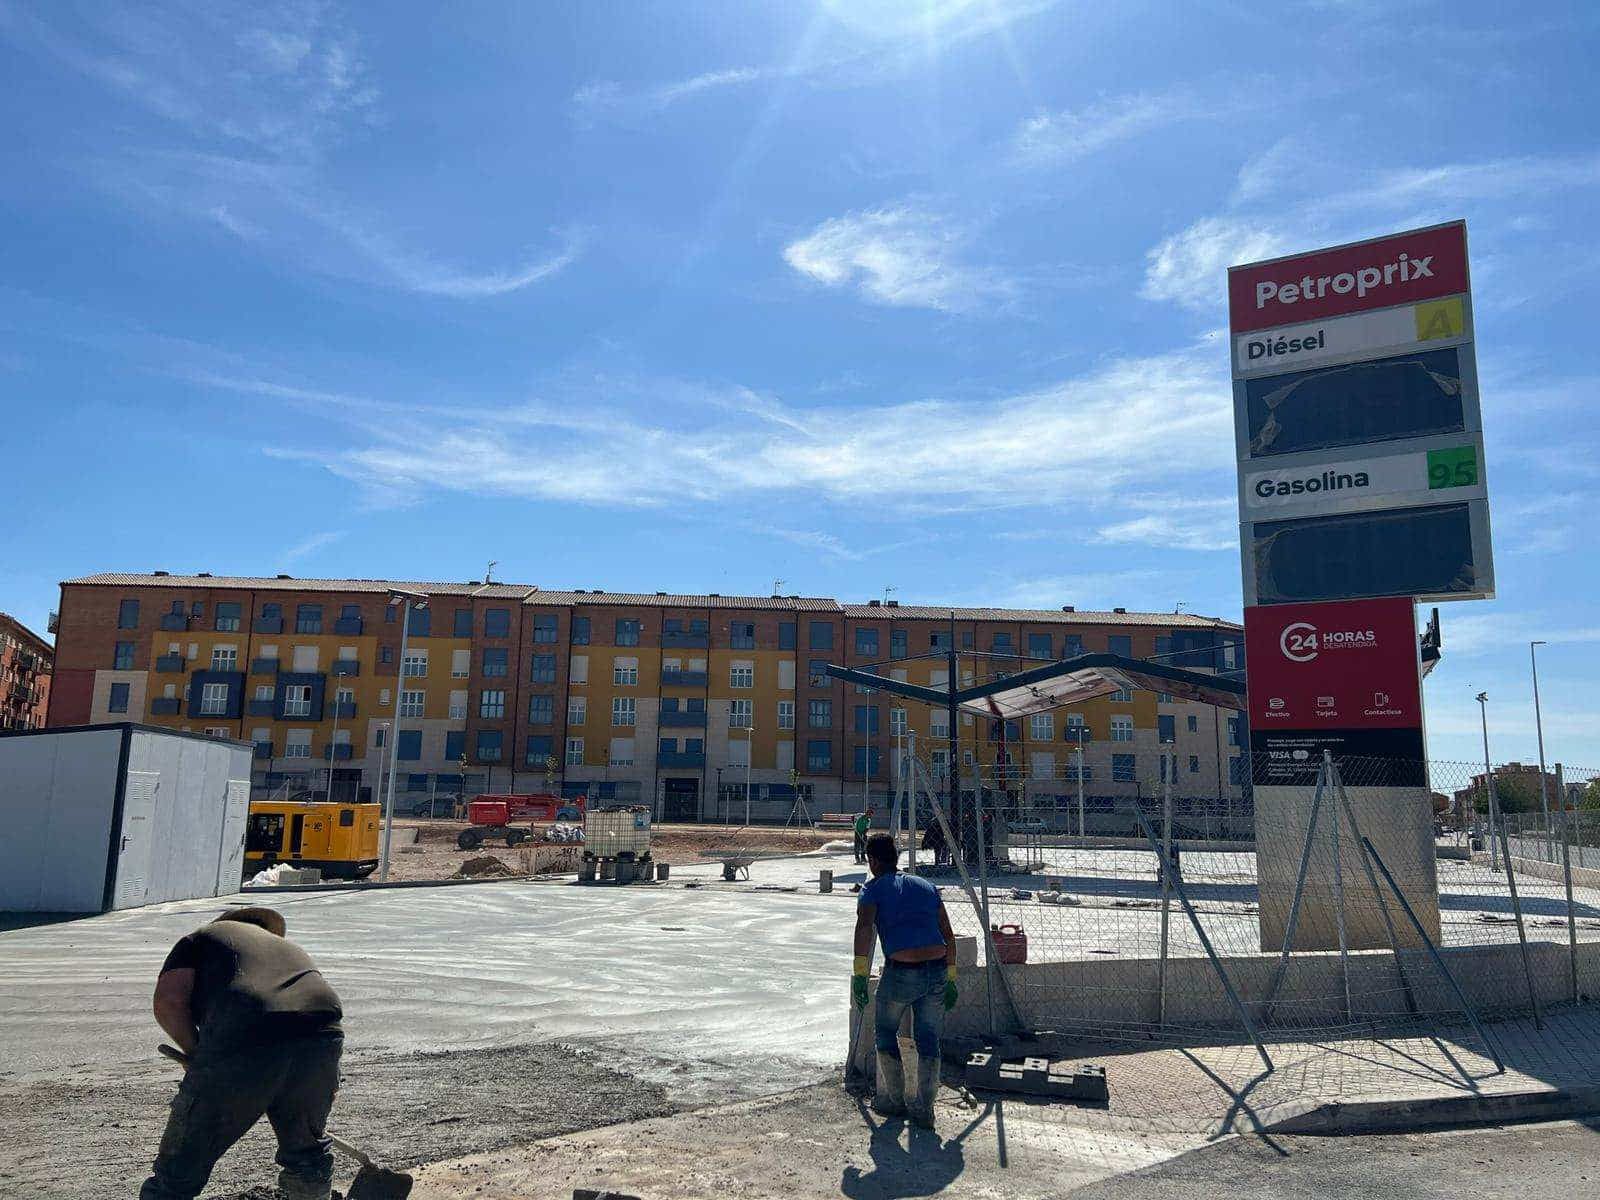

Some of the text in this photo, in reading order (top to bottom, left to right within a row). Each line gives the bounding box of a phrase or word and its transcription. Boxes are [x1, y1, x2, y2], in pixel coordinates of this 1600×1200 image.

[1256, 253, 1435, 309] Petroprix
[1247, 308, 1453, 361] Diésel A
[1255, 461, 1476, 497] Gasolina 95
[1290, 630, 1375, 650] 24 HORAS
[1315, 710, 1338, 718] Tarjeta
